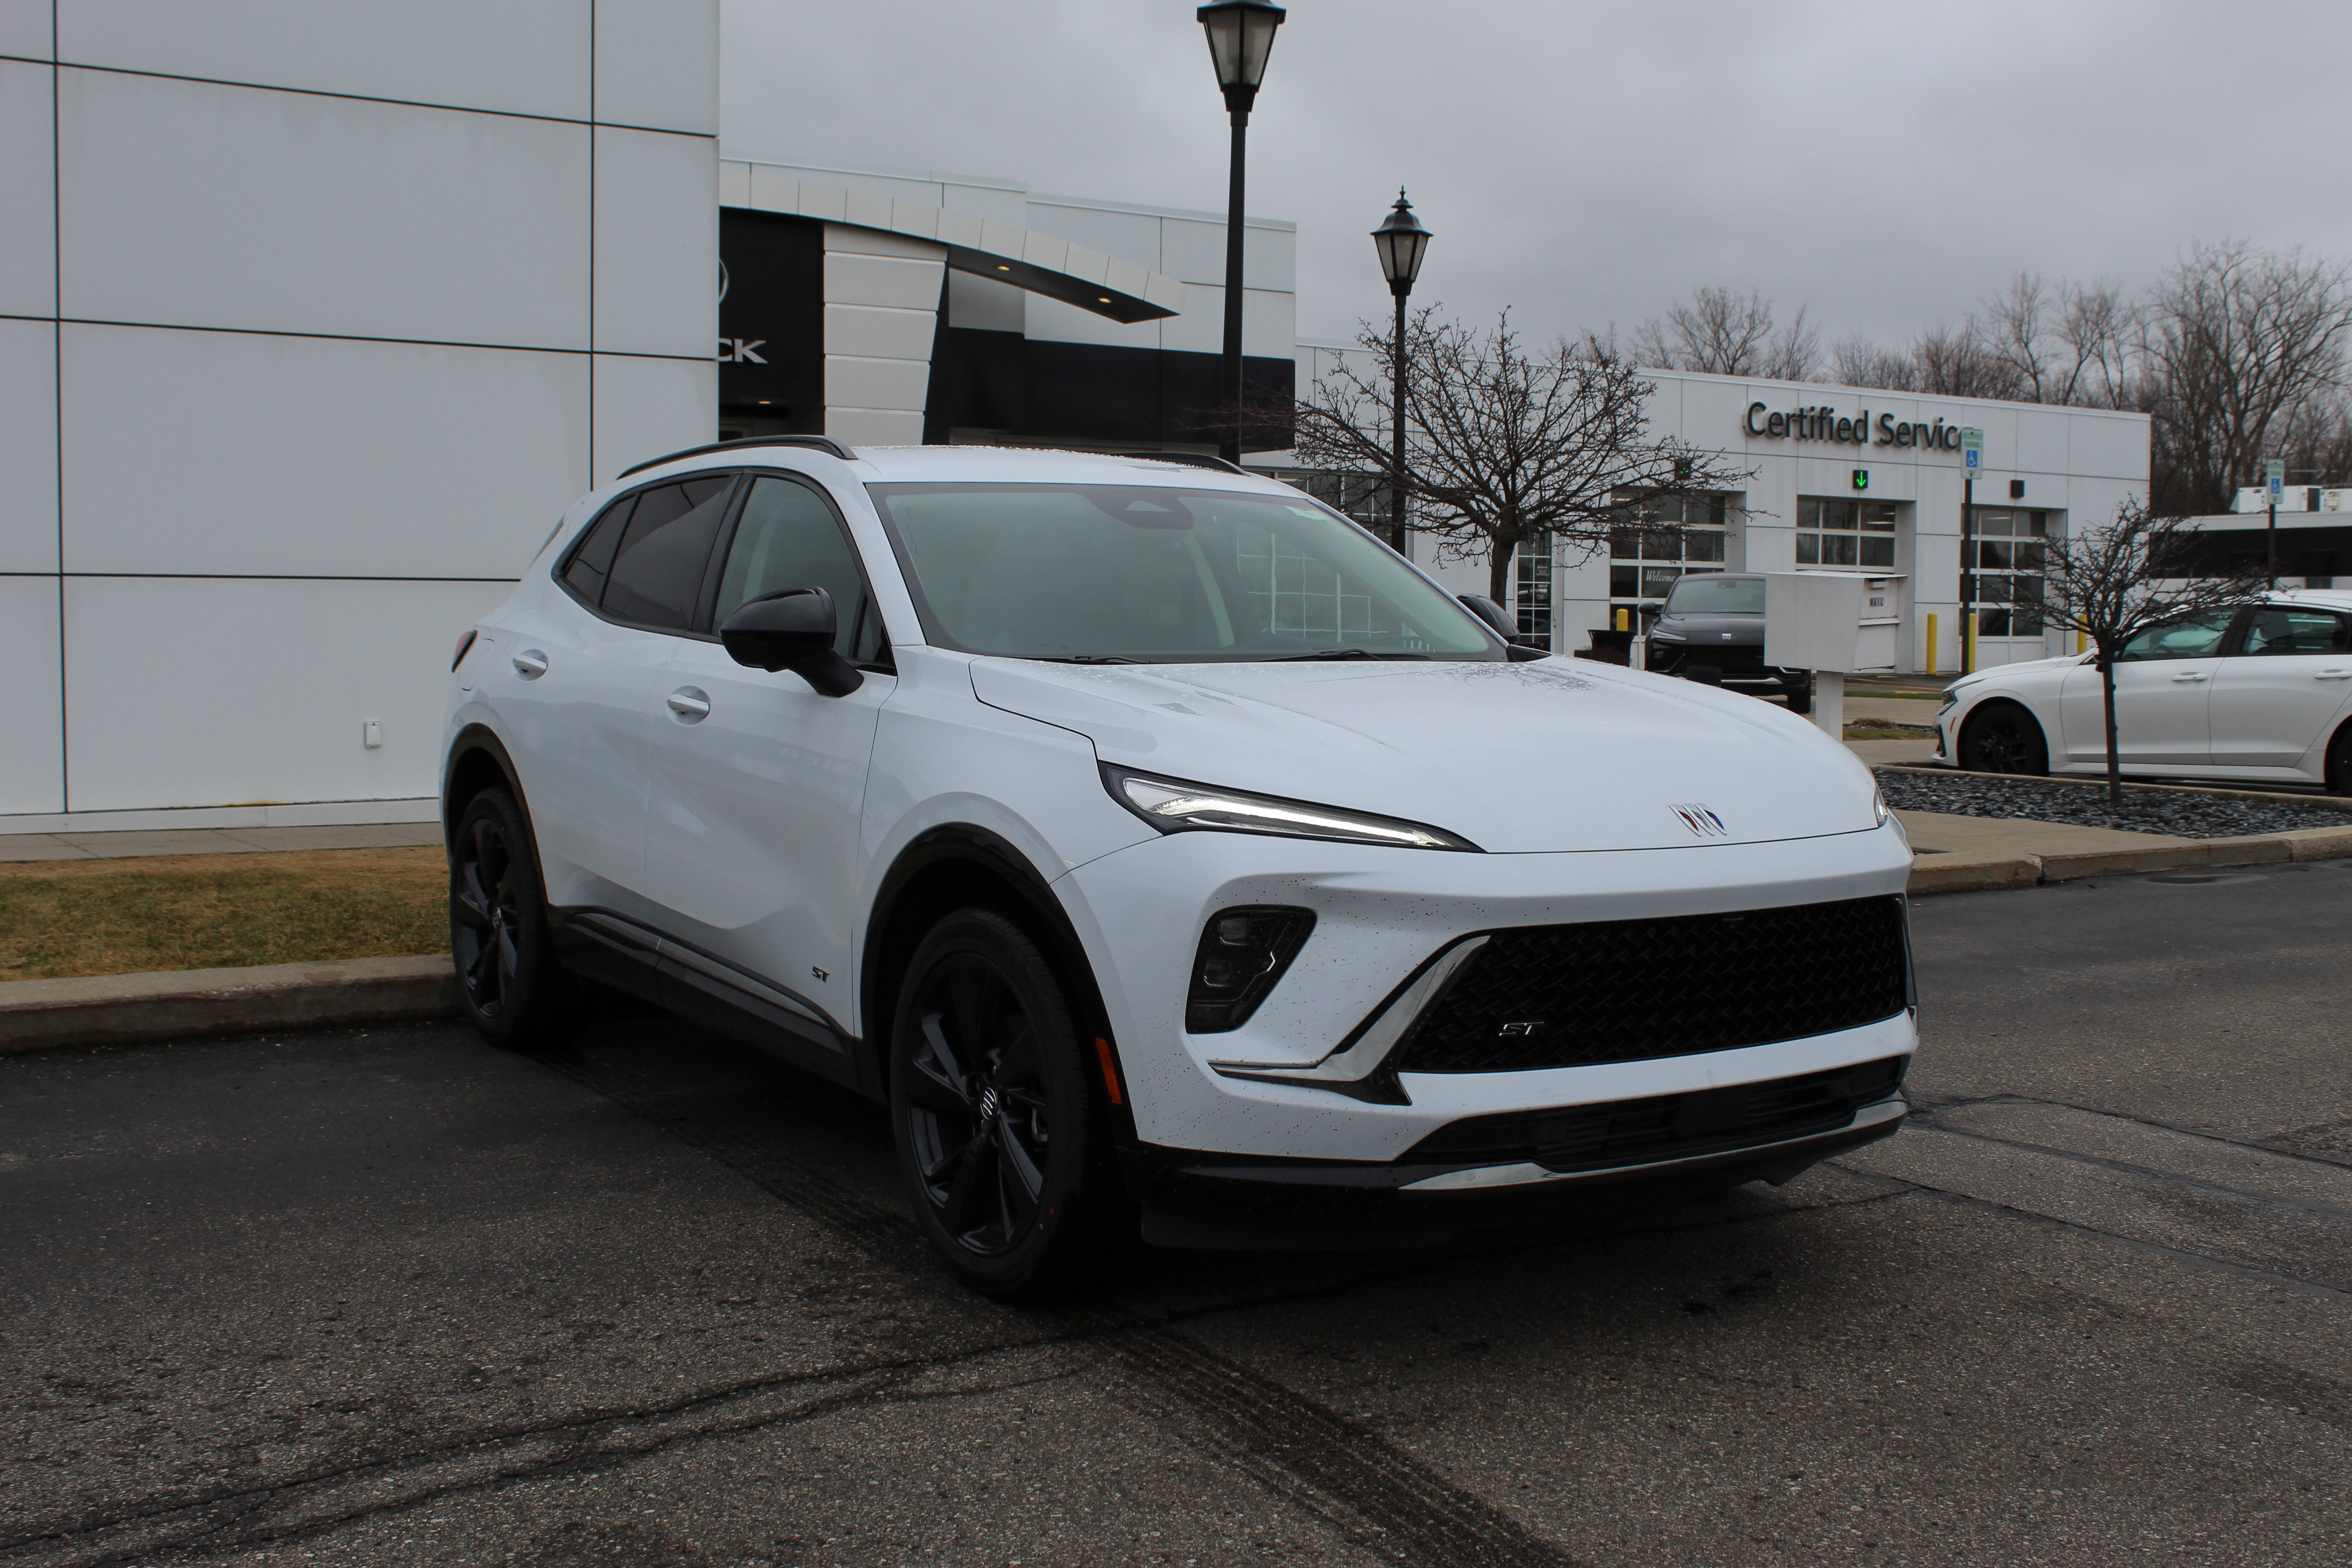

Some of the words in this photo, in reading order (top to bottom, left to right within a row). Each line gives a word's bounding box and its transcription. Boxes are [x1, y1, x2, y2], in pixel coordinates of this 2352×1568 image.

[1746, 401, 1869, 443] Certified
[1878, 412, 1961, 450] Servic
[1646, 570, 1675, 582] Welcome
[1869, 597, 1884, 607] MAIL
[811, 966, 830, 983] ST
[1499, 1021, 1544, 1036] ST
